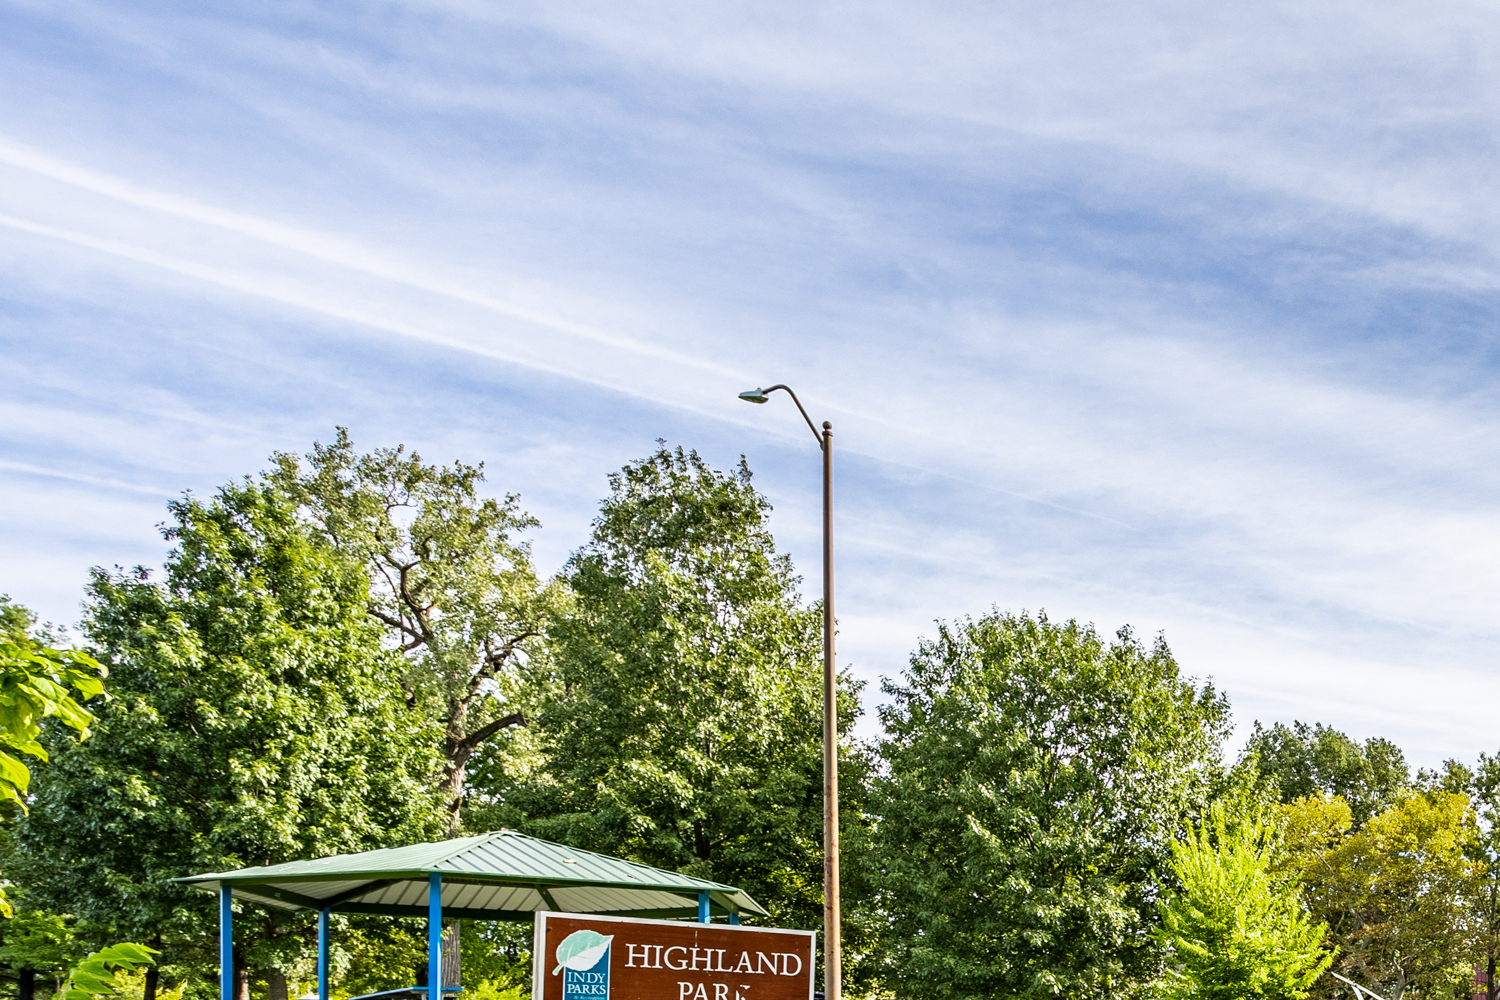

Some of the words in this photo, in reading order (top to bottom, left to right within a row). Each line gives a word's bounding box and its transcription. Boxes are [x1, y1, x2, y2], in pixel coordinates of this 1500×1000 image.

[625, 943, 802, 976] HIGHLAND
[567, 971, 606, 983] INDY
[566, 983, 606, 995] PARKS
